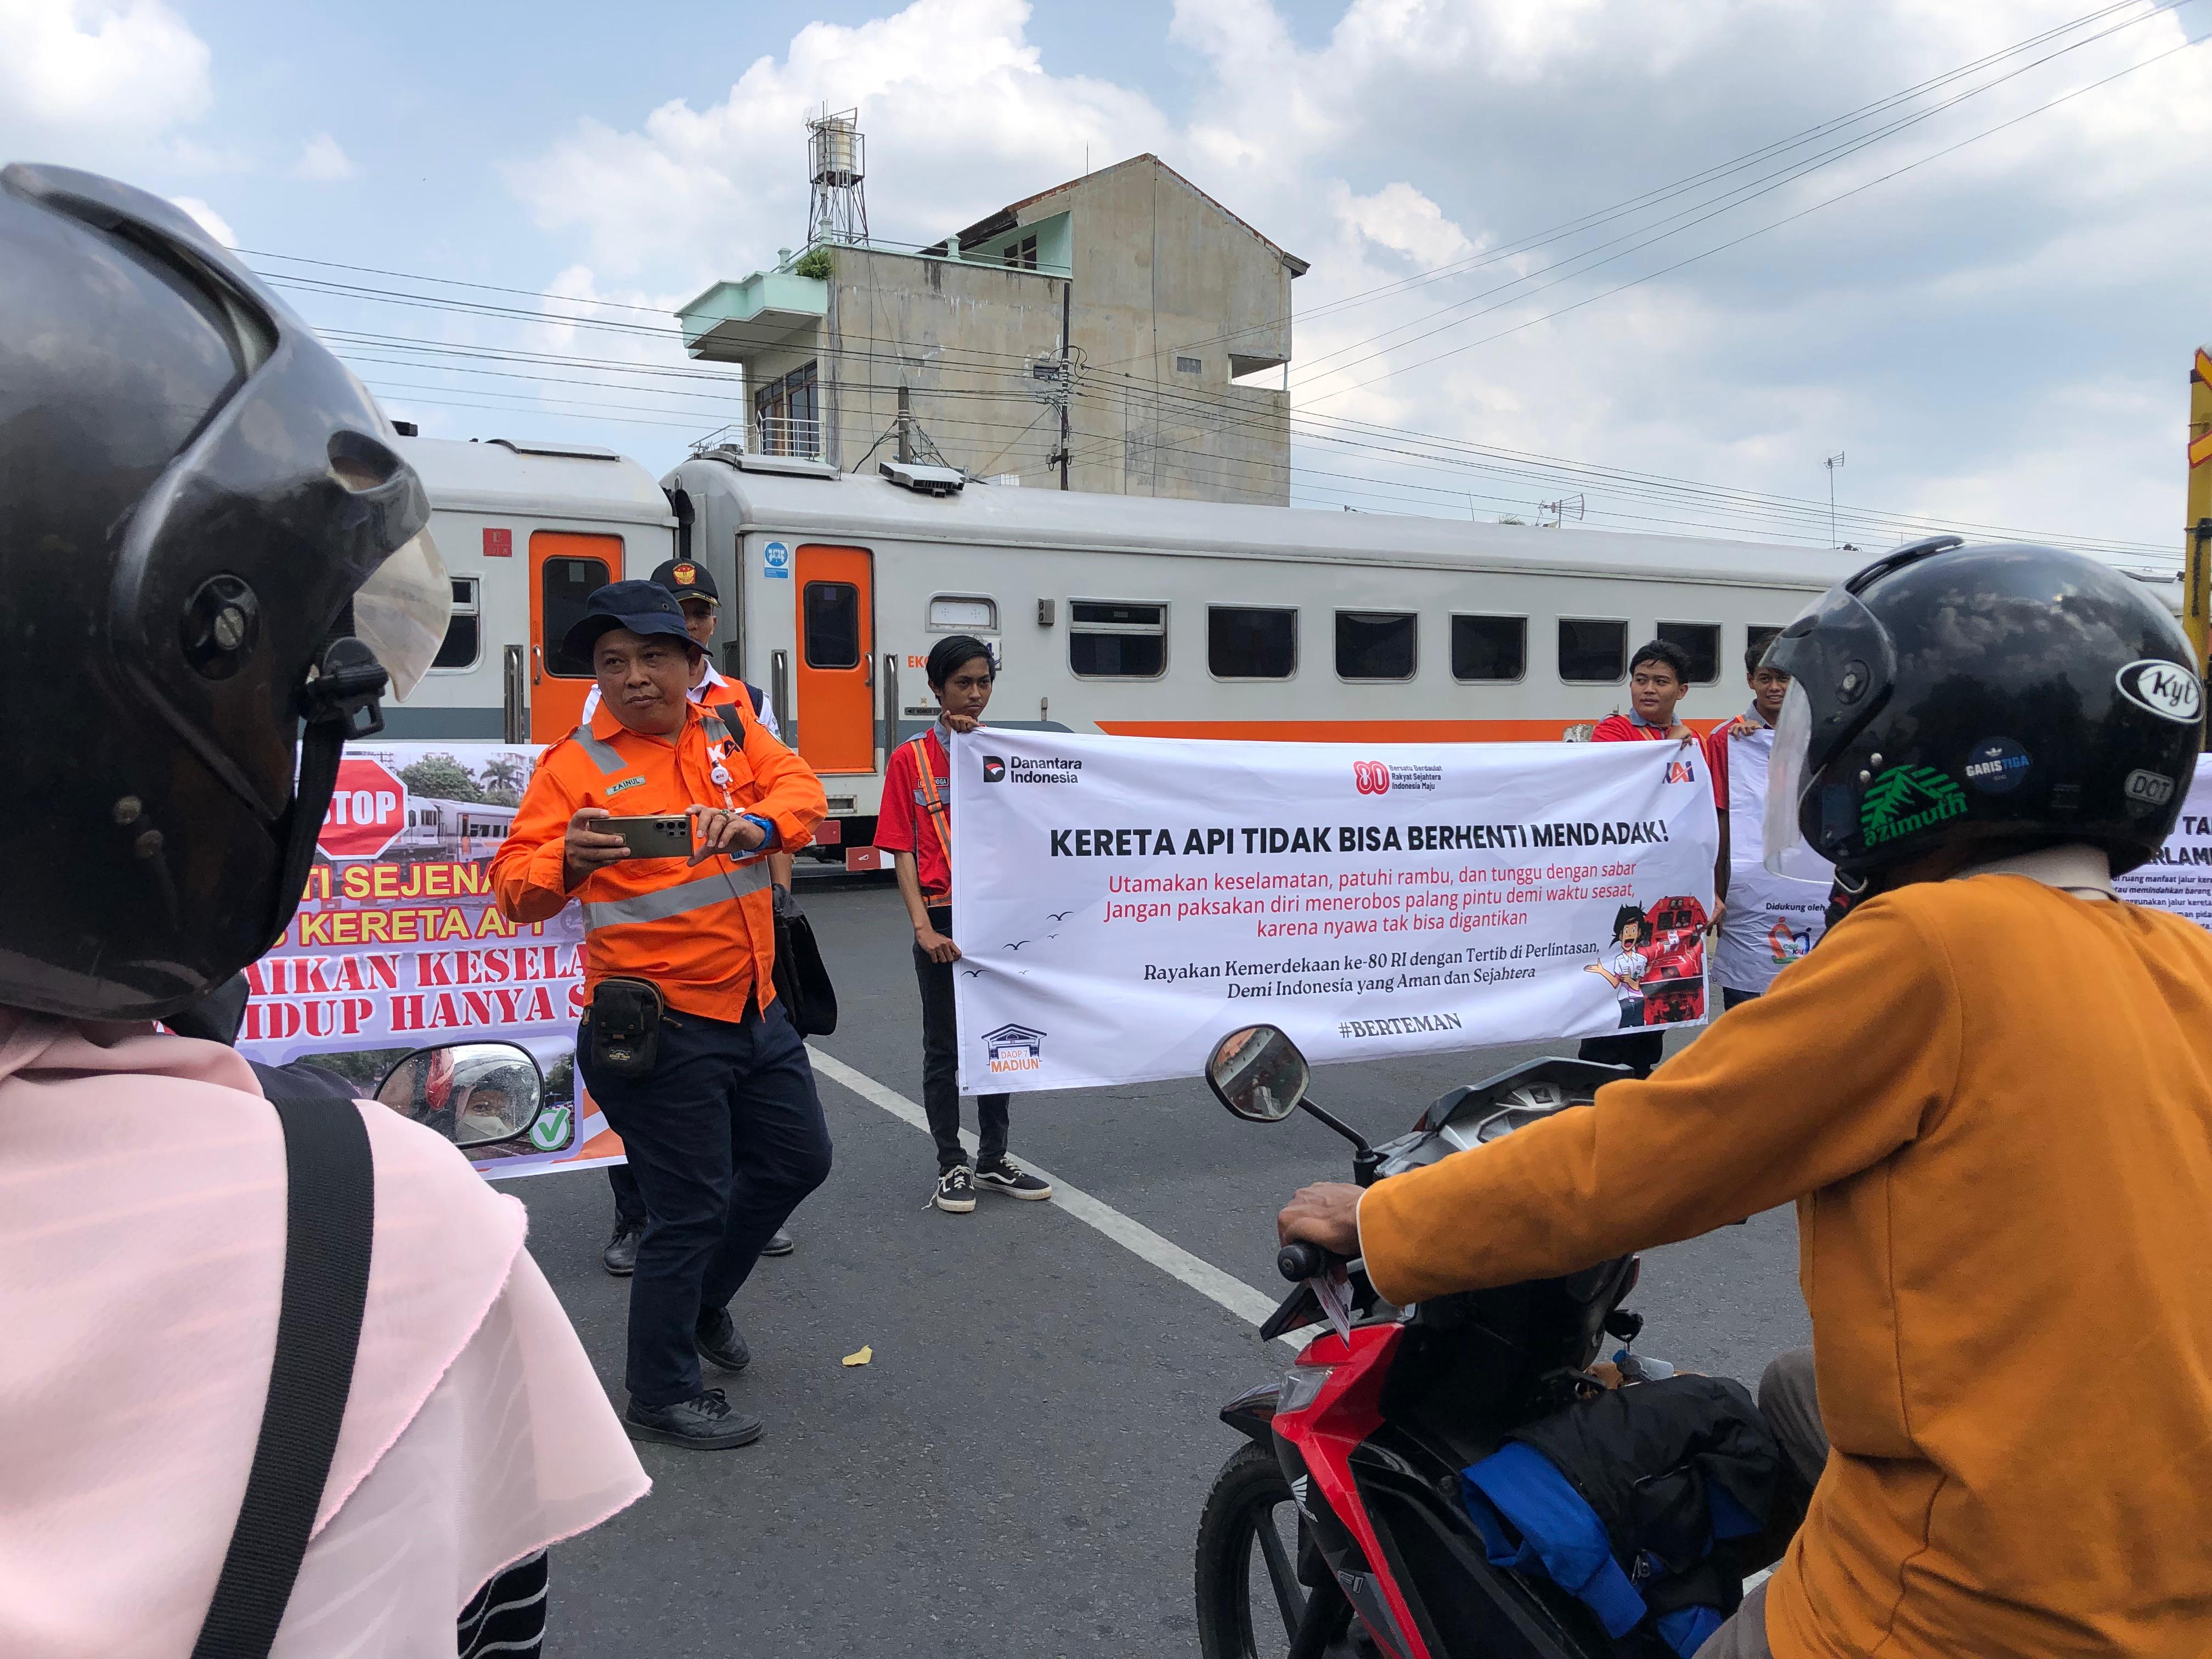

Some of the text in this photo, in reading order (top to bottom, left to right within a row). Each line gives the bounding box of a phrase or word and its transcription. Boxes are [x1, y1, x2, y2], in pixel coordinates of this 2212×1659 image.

[1011, 756, 1082, 769] Danantara
[612, 778, 641, 792] ZAINUL
[1011, 770, 1078, 783] Indonesia
[1353, 761, 1389, 795] 80
[1392, 772, 1441, 782] Rakyat Sejahtera
[323, 791, 396, 825] TOP
[1051, 820, 1668, 856] KERETA API TIDAK BISA BERHENTI MENDADAK!
[1110, 861, 1636, 893] Utamakan keselamatan, patuhi rambu, dan tunggu dengan sabar
[2178, 876, 2196, 884] jalur
[1104, 883, 1634, 922] Jangan paksakan diri menerobos palang pintu demi waktu sesaat,
[2168, 899, 2185, 907] jalur
[2185, 887, 2211, 896] barang
[1766, 902, 1825, 912] Didukung oleh
[302, 909, 470, 945] KERETA
[1258, 910, 1527, 939] karena nyawa tak bisa digantikan
[1144, 943, 1599, 983] Rayakan Kemerdekaan ke-80 RI dengan Tertib di Perlintasan,
[1227, 967, 1535, 998] Demi Indonesia yang Aman dan Sejahtera
[236, 998, 373, 1041] IDUP
[390, 986, 556, 1031] HANYA
[1338, 1013, 1462, 1039] #BERTEMAN
[991, 1058, 1038, 1072] MADIUN
